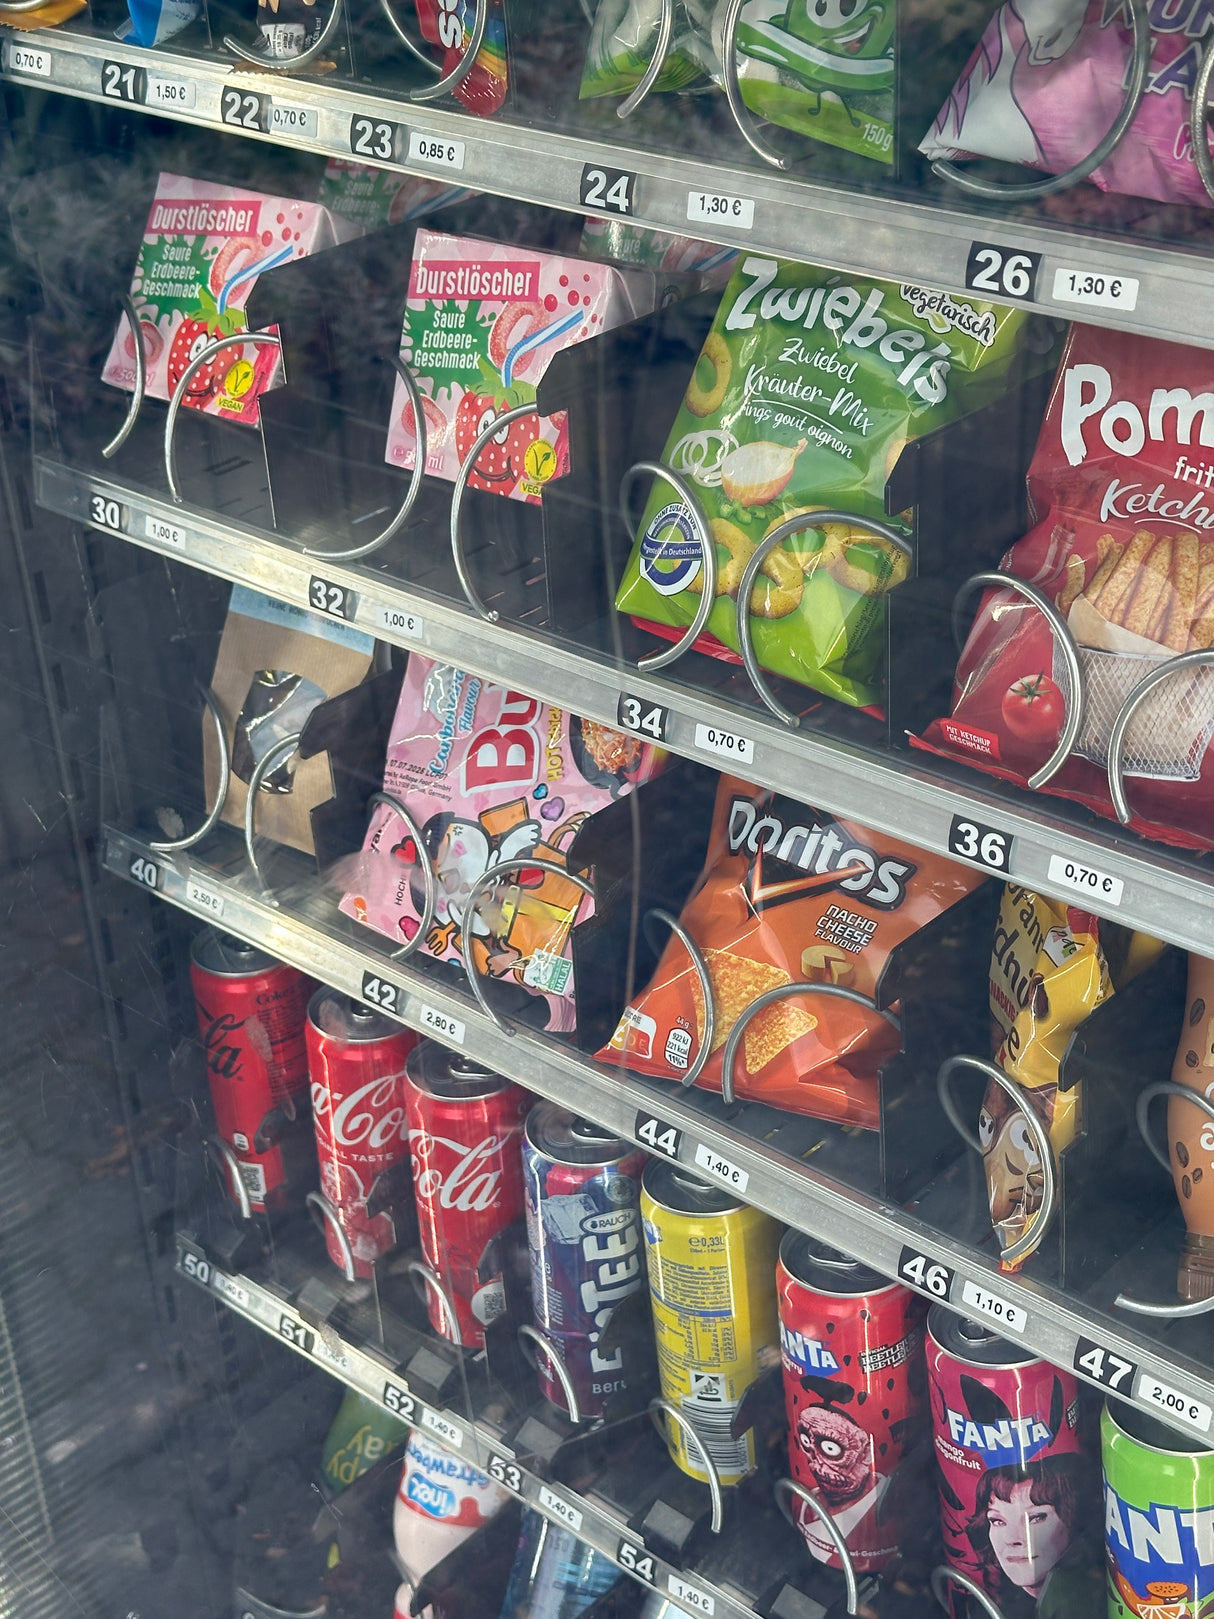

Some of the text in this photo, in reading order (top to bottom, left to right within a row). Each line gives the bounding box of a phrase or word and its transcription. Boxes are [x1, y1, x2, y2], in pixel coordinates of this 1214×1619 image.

[15, 52, 43, 70] 0,70 €
[104, 64, 136, 100] 21
[156, 85, 186, 101] 1,50 €
[224, 91, 260, 130] 22
[273, 108, 306, 126] 0,70 €
[354, 119, 392, 160] 23
[419, 141, 455, 161] 0,85 €
[863, 122, 893, 151] 150g
[584, 169, 629, 212] 24
[699, 194, 742, 216] 1,30 €
[151, 203, 254, 234] Durstlöscher
[162, 244, 193, 262] Saure
[151, 264, 201, 280] Erdbeere-
[415, 264, 532, 297] Durstlöscher
[971, 249, 1033, 297] 26
[1068, 274, 1122, 298] 1,30 €
[142, 281, 201, 299] Geschmack
[432, 310, 466, 328] Saure
[725, 256, 952, 404] Zwiebels
[422, 330, 478, 350] Erdbeere-
[413, 350, 481, 370] Geschmack
[778, 337, 859, 385] Zwiebel
[217, 397, 244, 412] VEGAN
[744, 364, 874, 437] Kräuter-Mix
[1060, 363, 1214, 467] Pom
[807, 421, 853, 460] oignon
[1173, 456, 1214, 489] frit
[521, 482, 543, 496] VEGA
[1100, 478, 1214, 530] Ketchu
[90, 496, 120, 530] 30
[152, 523, 178, 542] 1,00 €
[668, 547, 702, 556] Deutschland
[311, 580, 344, 617] 32
[383, 610, 415, 630] 1,00 €
[459, 678, 482, 734] Flavour
[621, 698, 663, 739] 34
[462, 682, 540, 794] Bu
[545, 706, 564, 781] HOT Chick
[707, 729, 746, 753] 0,70 €
[945, 725, 991, 747] MIT KETCHUP
[949, 734, 992, 755] GESCHMACK
[728, 800, 909, 904] Doritos
[953, 822, 1006, 867] 36
[130, 857, 158, 888] 40
[1064, 863, 1113, 893] 0,70 €
[193, 889, 219, 909] 2,50 €
[816, 916, 873, 947] CHEESE
[825, 904, 878, 934] NACHO
[814, 928, 863, 955] FLAVOUR
[554, 962, 571, 993] HALAL
[363, 978, 396, 1013] 42
[426, 1011, 456, 1035] 2,80 €
[638, 1119, 677, 1156] 44
[351, 1151, 394, 1163] TASTE
[706, 1155, 740, 1183] 1,40 €
[598, 1212, 631, 1229] RAUCH
[184, 1252, 210, 1284] 50
[902, 1255, 949, 1297] 46
[975, 1292, 1016, 1322] 1,10 €
[280, 1318, 307, 1349] 51
[780, 1320, 839, 1369] ANTA
[861, 1340, 905, 1365] BEETLE
[863, 1349, 906, 1374] BEETLE
[1079, 1347, 1133, 1389] 47
[592, 1379, 627, 1395] Ber
[384, 1386, 415, 1422] 52
[1152, 1386, 1199, 1420] 2,00 €
[429, 1416, 457, 1439] 1,40 €
[946, 1408, 1050, 1451] FANTA
[489, 1455, 522, 1493] 53
[547, 1495, 575, 1522] 1,40 €
[1103, 1480, 1214, 1568] ANT
[619, 1542, 653, 1581] 54
[678, 1586, 710, 1610] 1,40 €
